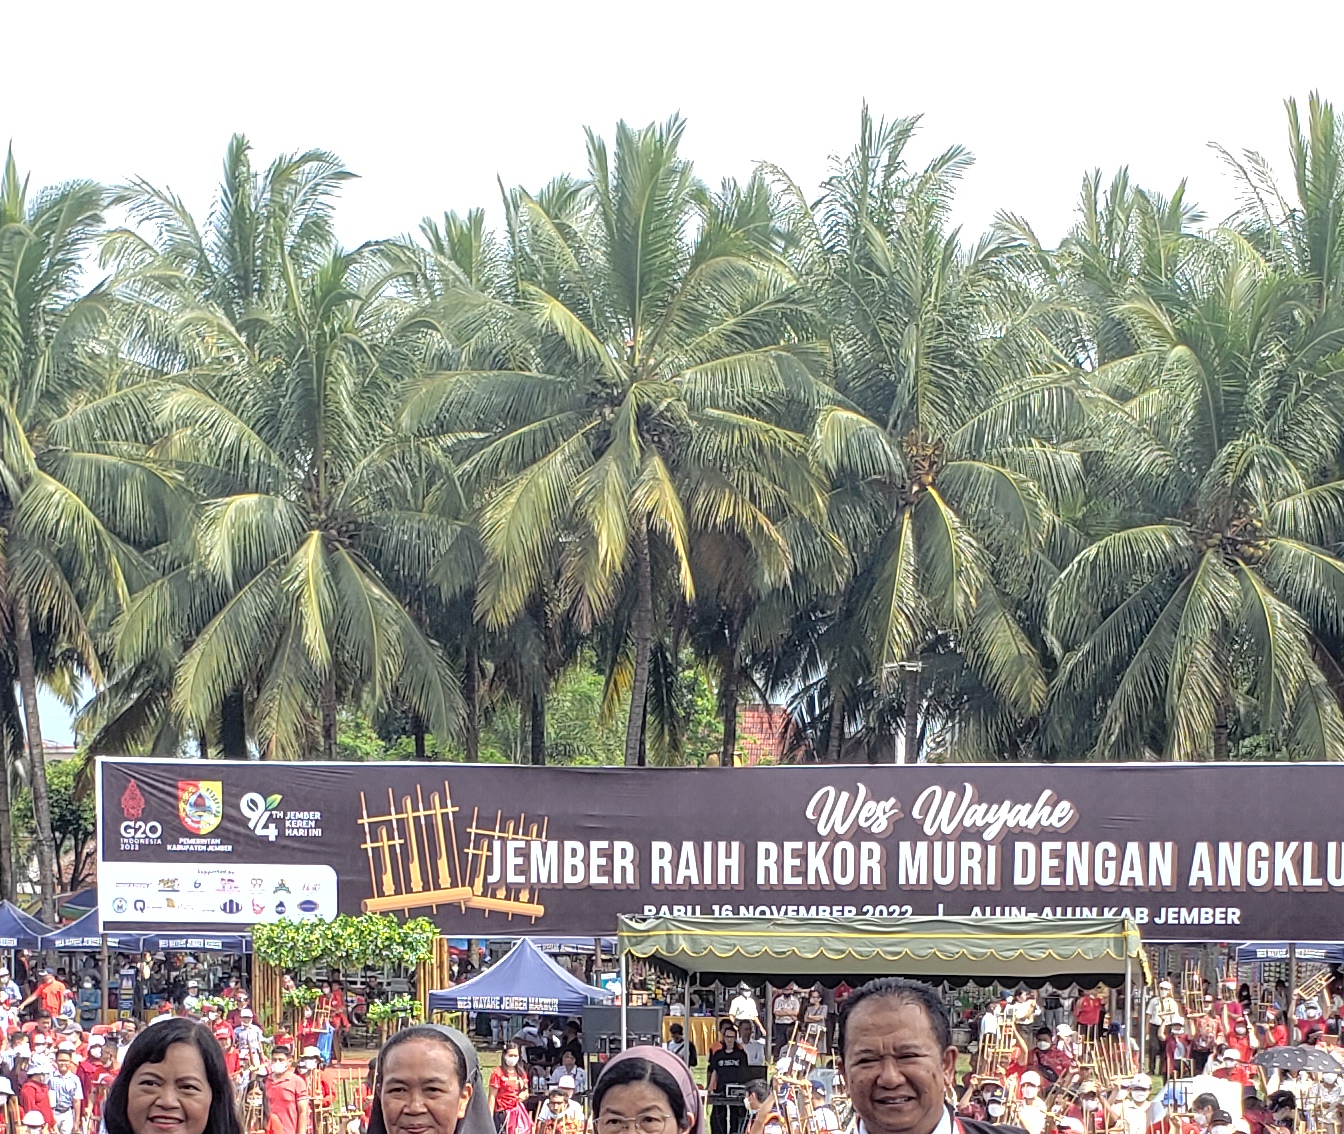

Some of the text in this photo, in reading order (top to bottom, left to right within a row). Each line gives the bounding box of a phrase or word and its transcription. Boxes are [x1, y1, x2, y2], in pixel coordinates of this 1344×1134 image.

[285, 811, 321, 820] JEMBER
[805, 783, 1074, 841] Wes Wayahe
[120, 821, 163, 839] G20
[285, 820, 316, 829] KEREN
[285, 828, 322, 837] HARI INI
[167, 844, 233, 852] KABUPATEN JEMBER
[487, 840, 635, 886] JEMBER
[650, 840, 739, 886] RAIH
[757, 840, 882, 886] REKOR
[898, 840, 997, 887] MURI
[1014, 841, 1172, 887] DENGAN
[739, 905, 856, 917] NOVEMBER
[1101, 907, 1149, 924] KAB
[1154, 907, 1241, 925] JEMBER
